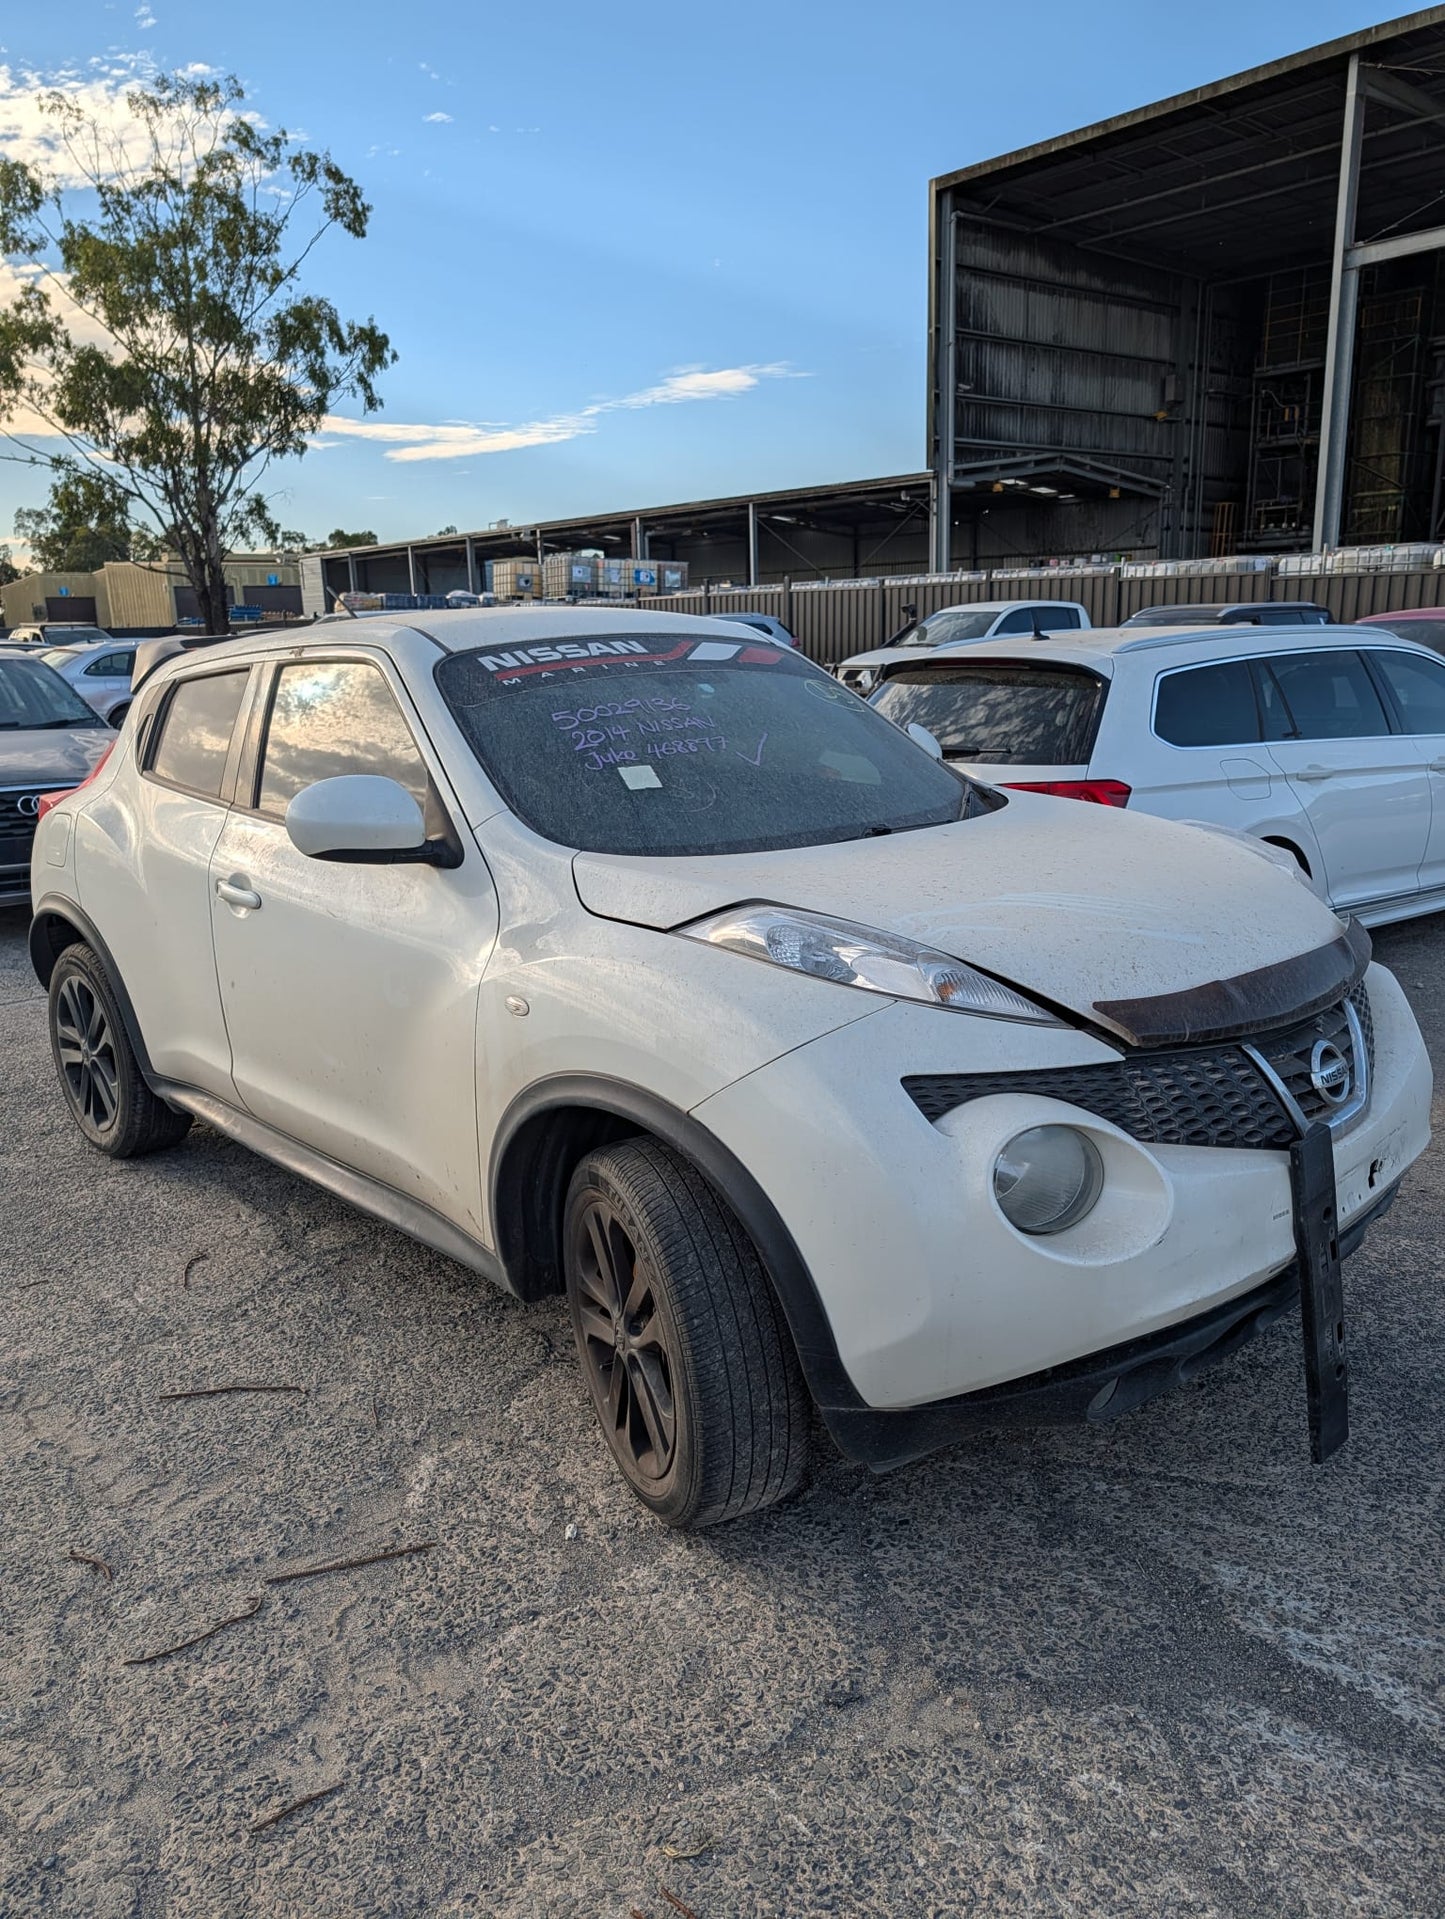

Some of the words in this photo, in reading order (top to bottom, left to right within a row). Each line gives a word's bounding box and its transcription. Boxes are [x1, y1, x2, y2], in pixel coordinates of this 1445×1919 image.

[477, 640, 649, 672] NISSAN
[502, 660, 667, 686] MARINE
[551, 697, 692, 730] 50029136
[571, 724, 631, 750] 2014
[637, 715, 716, 737] NISSAN
